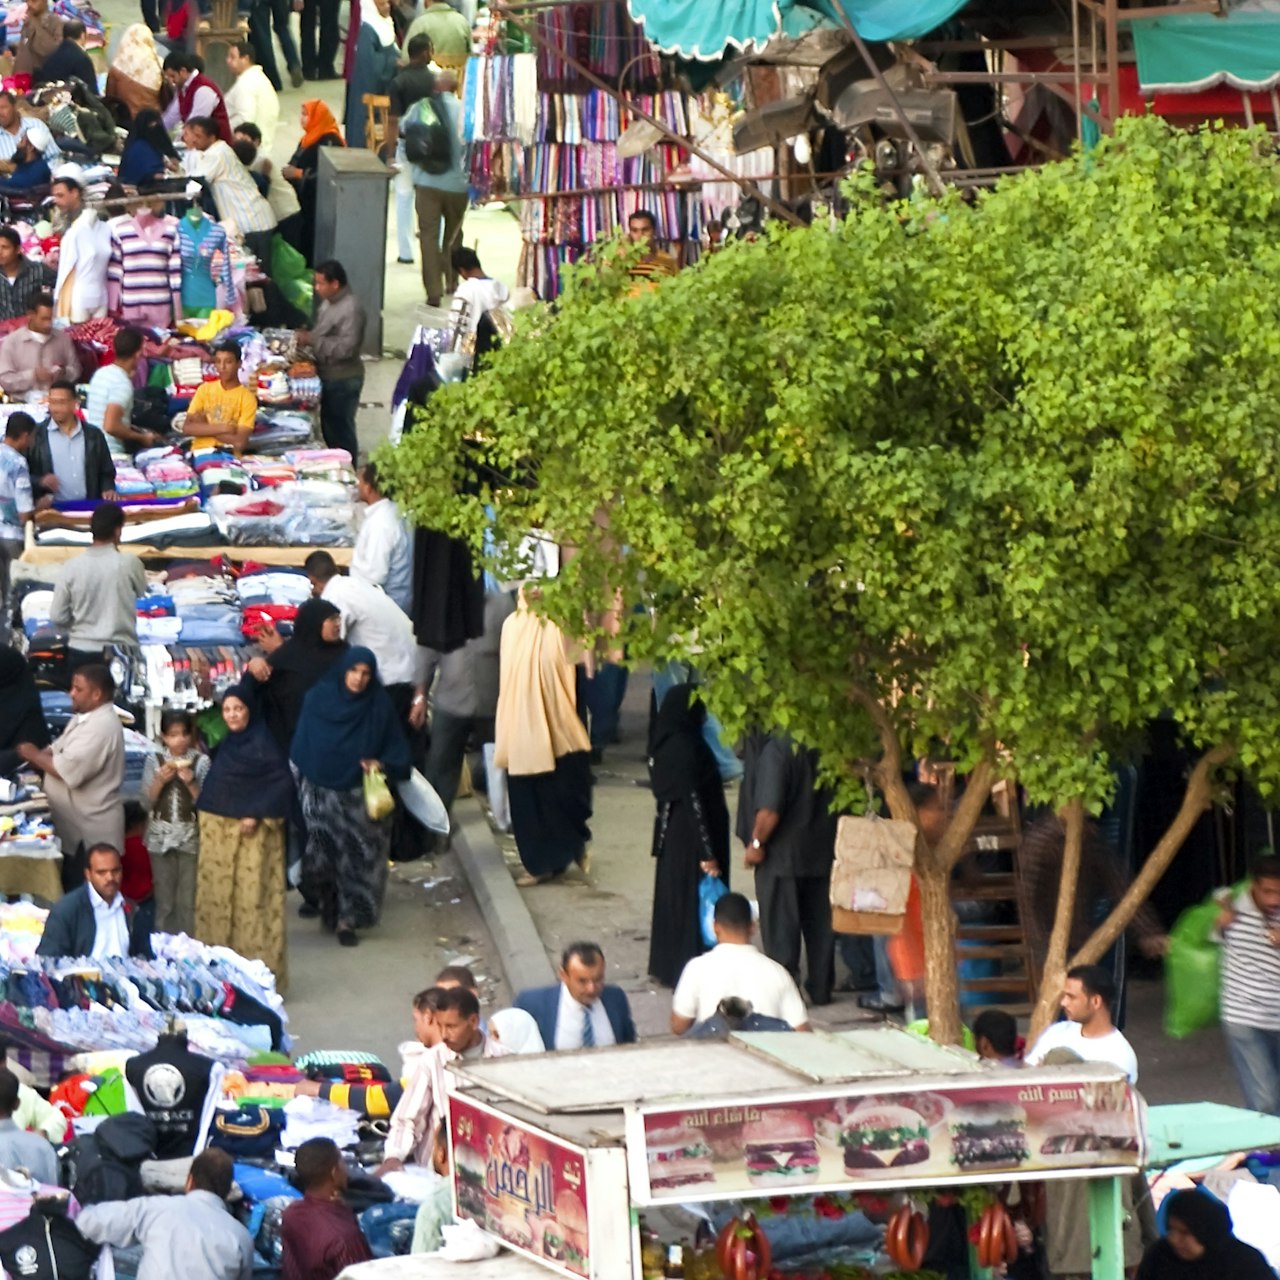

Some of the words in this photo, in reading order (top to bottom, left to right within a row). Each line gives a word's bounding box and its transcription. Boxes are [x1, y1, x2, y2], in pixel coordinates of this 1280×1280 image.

[1018, 1085, 1044, 1102] الله
[1048, 1088, 1078, 1104] بسم
[684, 1109, 709, 1128] الله
